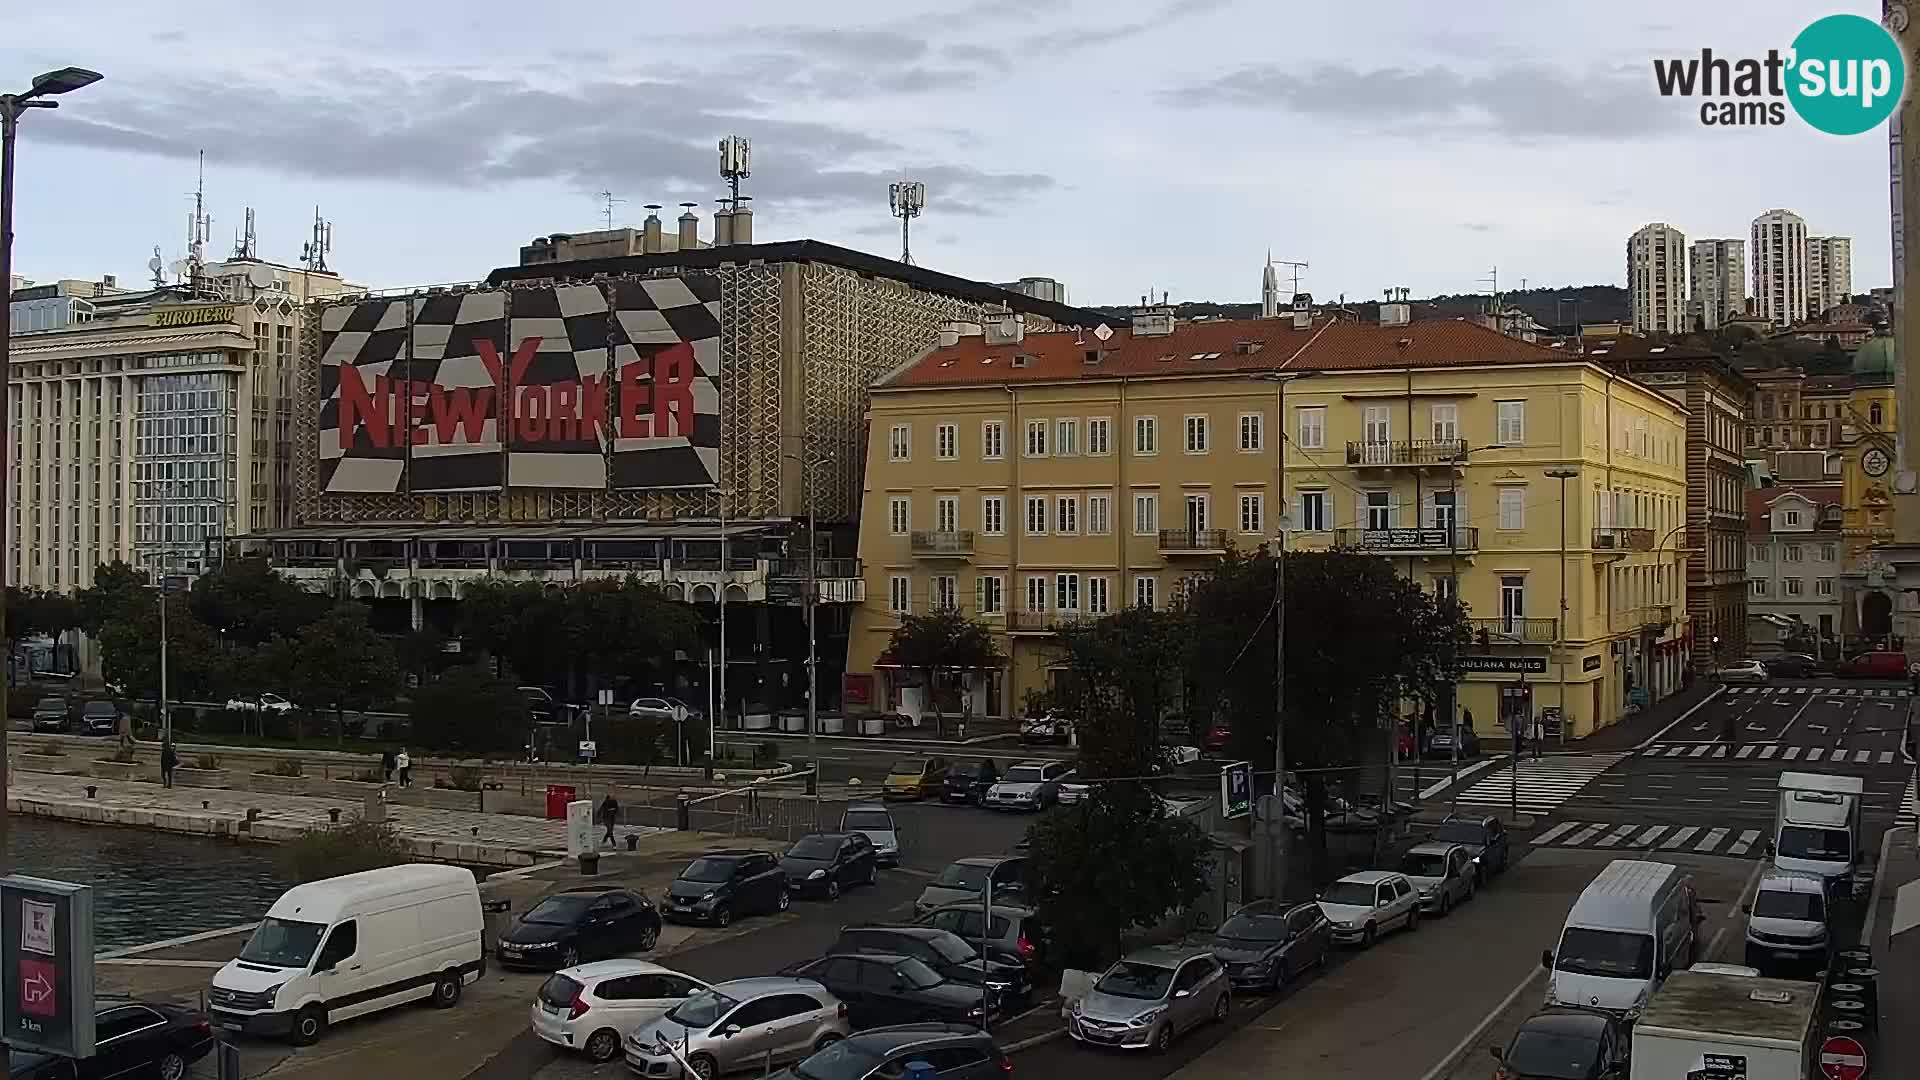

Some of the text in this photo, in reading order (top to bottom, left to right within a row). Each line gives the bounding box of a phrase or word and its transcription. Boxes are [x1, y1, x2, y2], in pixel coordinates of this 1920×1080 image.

[339, 336, 696, 449] NEW YORKER
[1459, 660, 1505, 669] JULIANA
[28, 1019, 42, 1032] km
